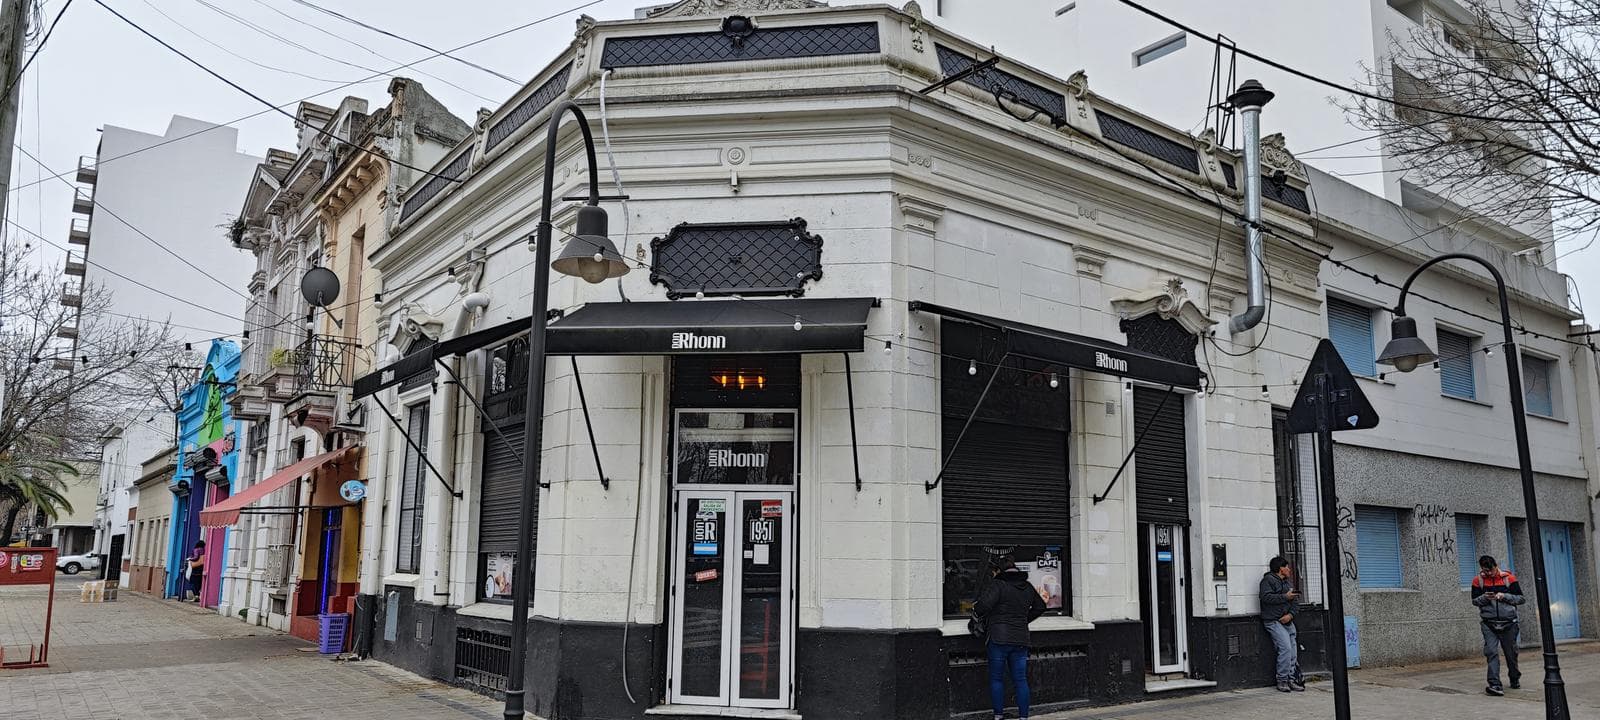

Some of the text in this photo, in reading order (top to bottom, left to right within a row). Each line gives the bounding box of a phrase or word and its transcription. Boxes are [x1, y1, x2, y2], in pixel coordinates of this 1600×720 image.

[680, 333, 726, 349] Rhonn
[1100, 353, 1127, 372] Rhonn
[718, 449, 765, 467] Rhonn
[704, 521, 716, 540] R
[751, 521, 772, 541] 1951
